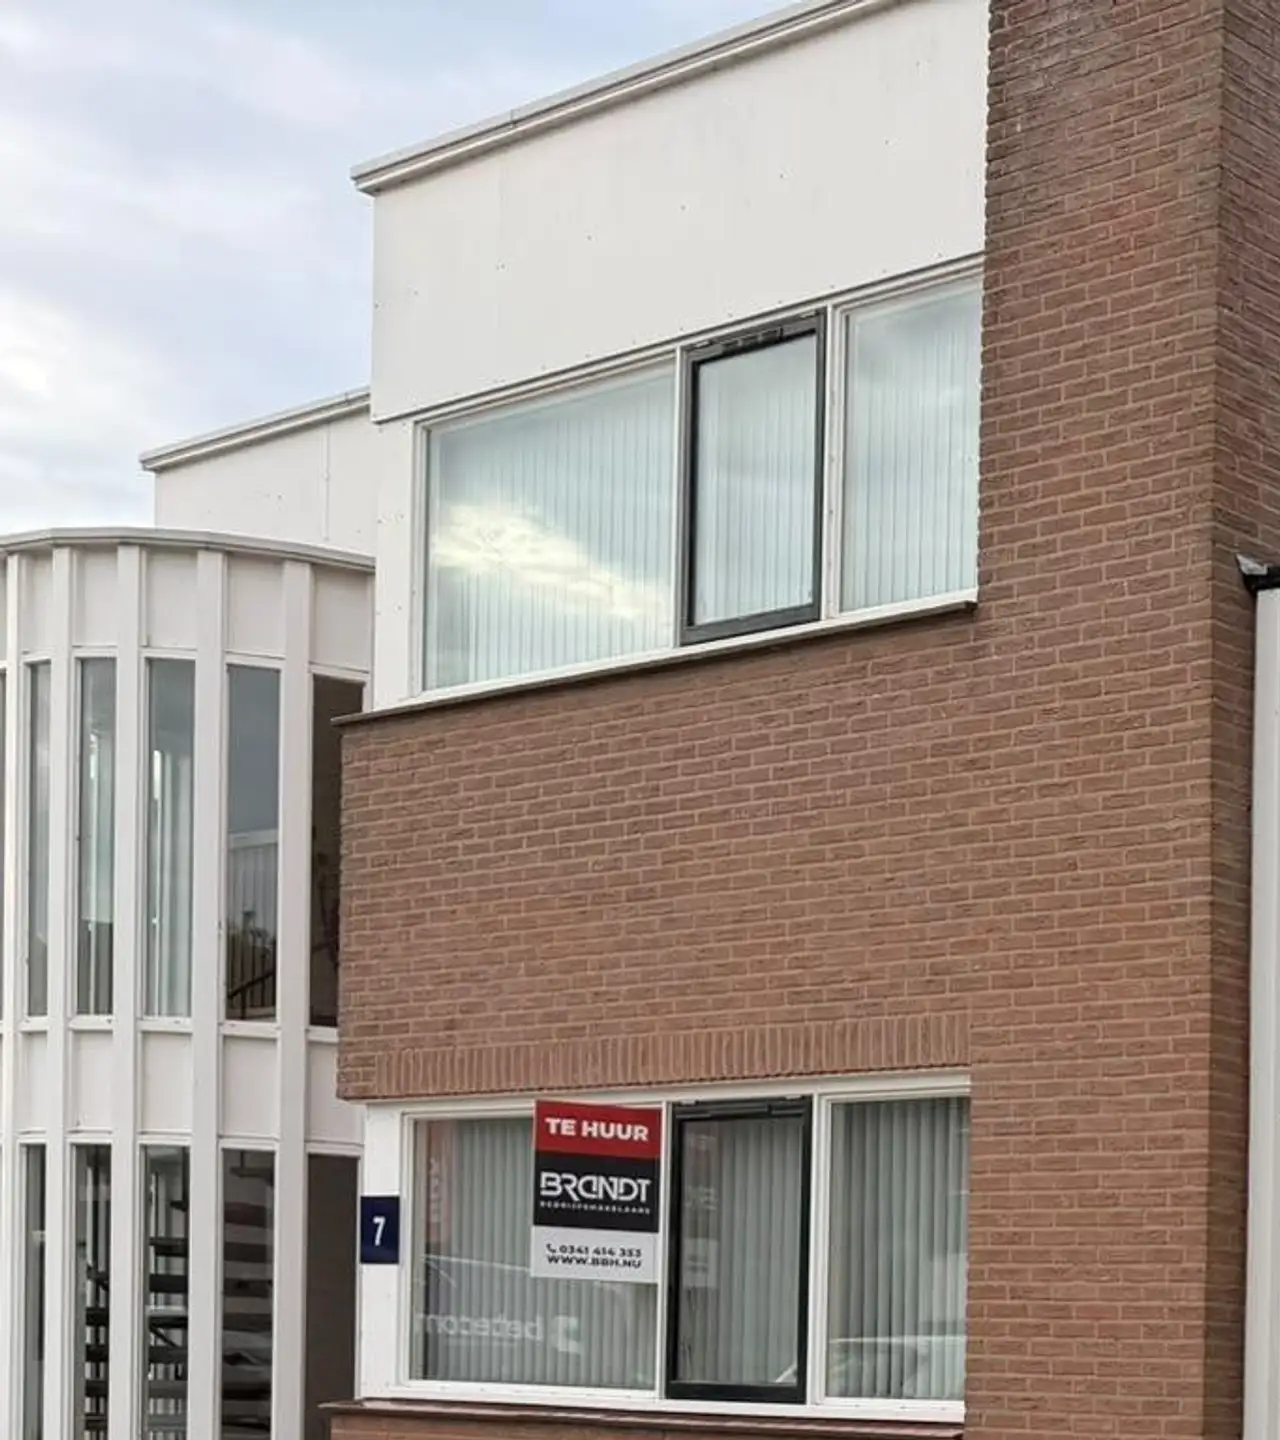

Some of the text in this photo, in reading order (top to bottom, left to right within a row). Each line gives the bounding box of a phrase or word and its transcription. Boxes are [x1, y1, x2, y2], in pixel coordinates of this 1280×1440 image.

[544, 1117, 649, 1141] TE HUUR
[540, 1171, 652, 1204] BRANDT
[372, 1215, 386, 1247] 7
